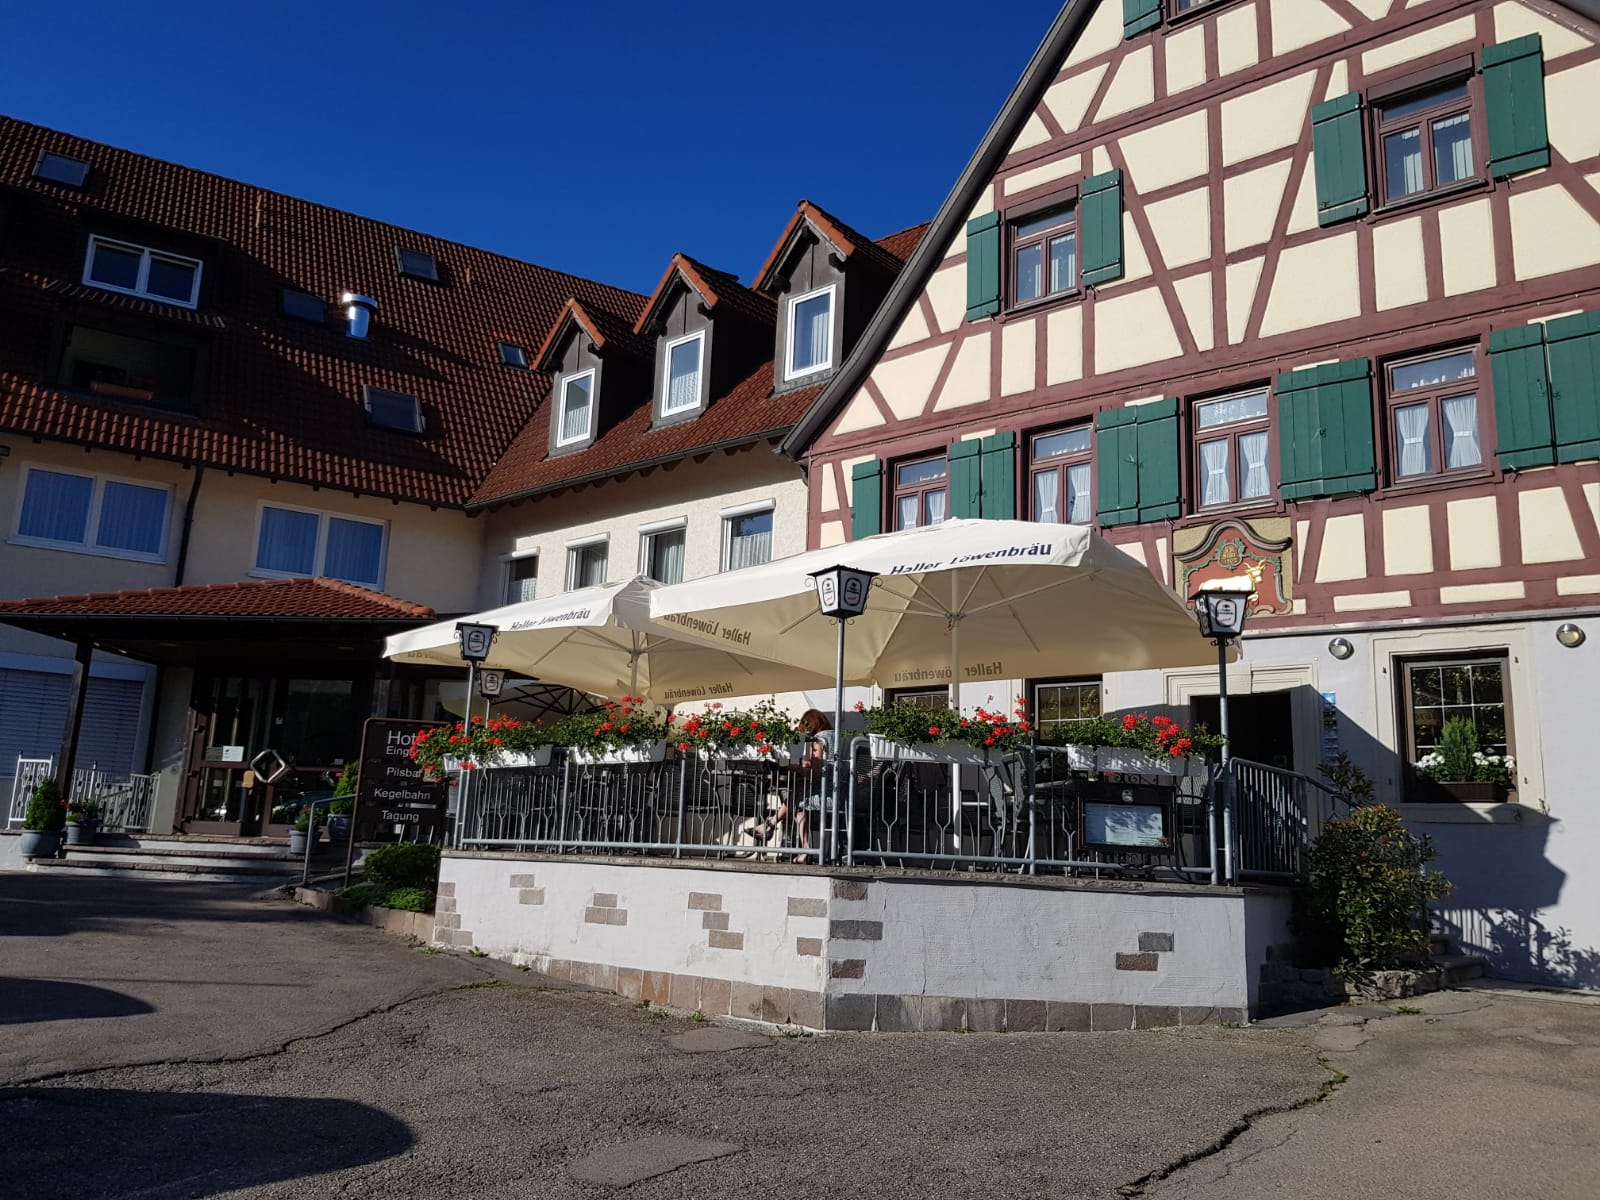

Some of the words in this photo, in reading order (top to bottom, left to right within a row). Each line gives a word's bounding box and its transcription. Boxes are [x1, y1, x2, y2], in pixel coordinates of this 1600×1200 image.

[890, 561, 943, 575] Haller
[950, 542, 1052, 565] Löwenbräu
[508, 620, 537, 631] Haller
[387, 730, 418, 746] Hot
[374, 788, 431, 801] Kegelbahn
[381, 810, 420, 823] Tagung
